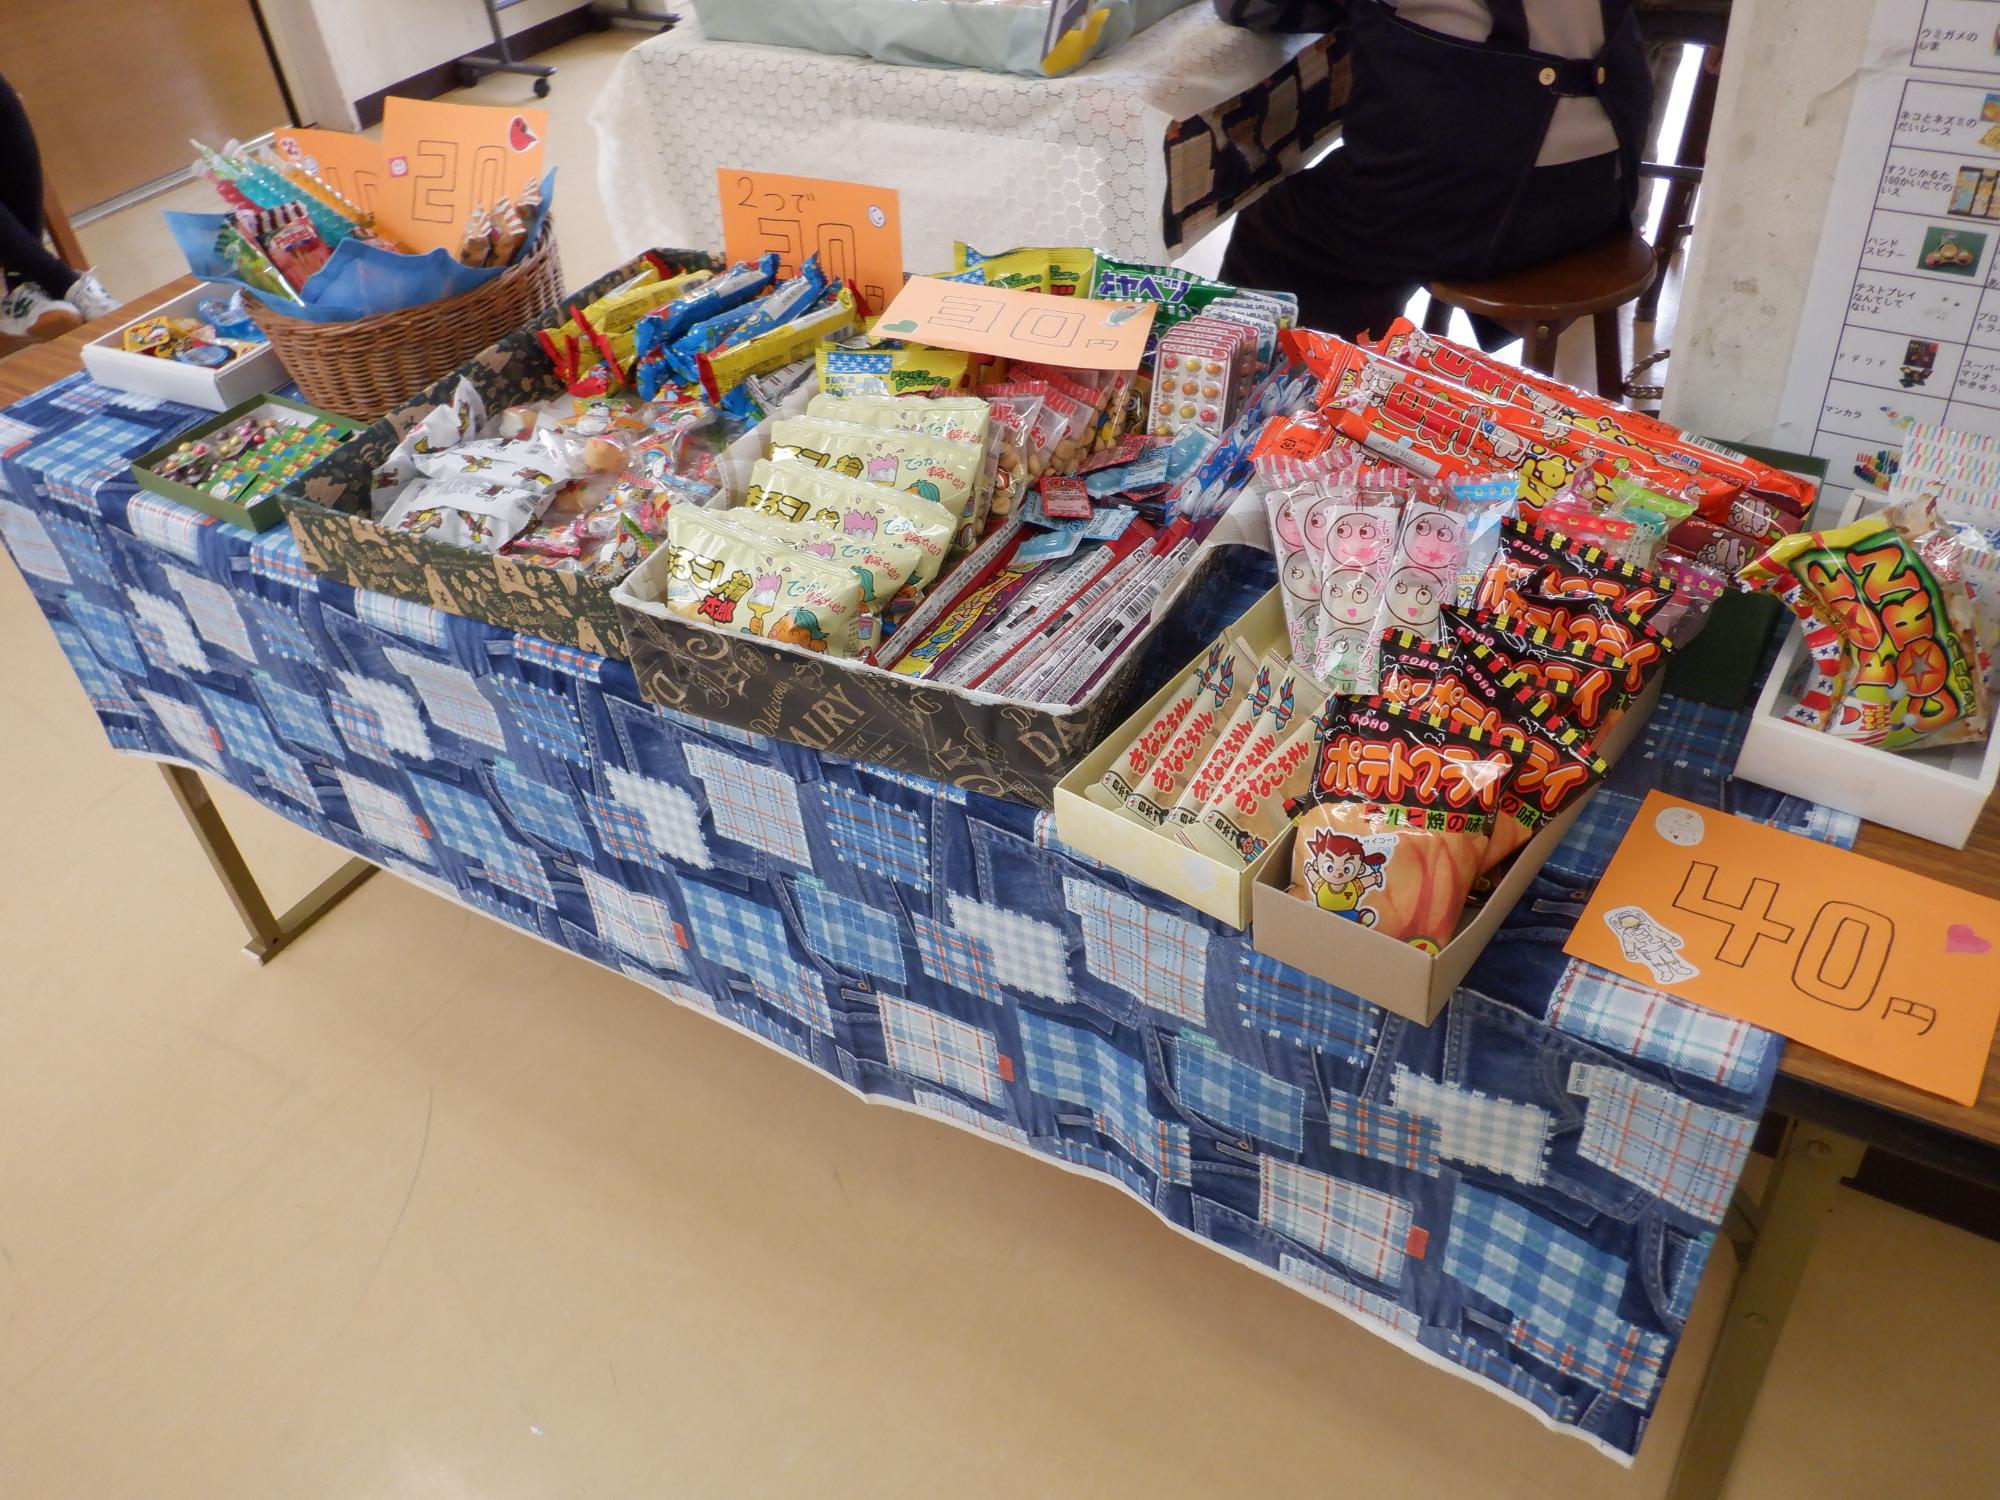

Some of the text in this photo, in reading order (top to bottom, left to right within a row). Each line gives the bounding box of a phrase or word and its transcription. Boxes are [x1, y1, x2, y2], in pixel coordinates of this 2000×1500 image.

[737, 177, 816, 213] 2つで
[1099, 270, 1193, 303] キャベツ
[1511, 539, 1550, 561] TOHO
[1399, 653, 1440, 672] TOHO
[1465, 663, 1496, 699] TOHO
[1129, 697, 1194, 776] きなこちゃん
[1348, 712, 1391, 732] TOHO
[1151, 711, 1214, 794] きなこちゃん
[1234, 741, 1310, 816] きなこちゃん
